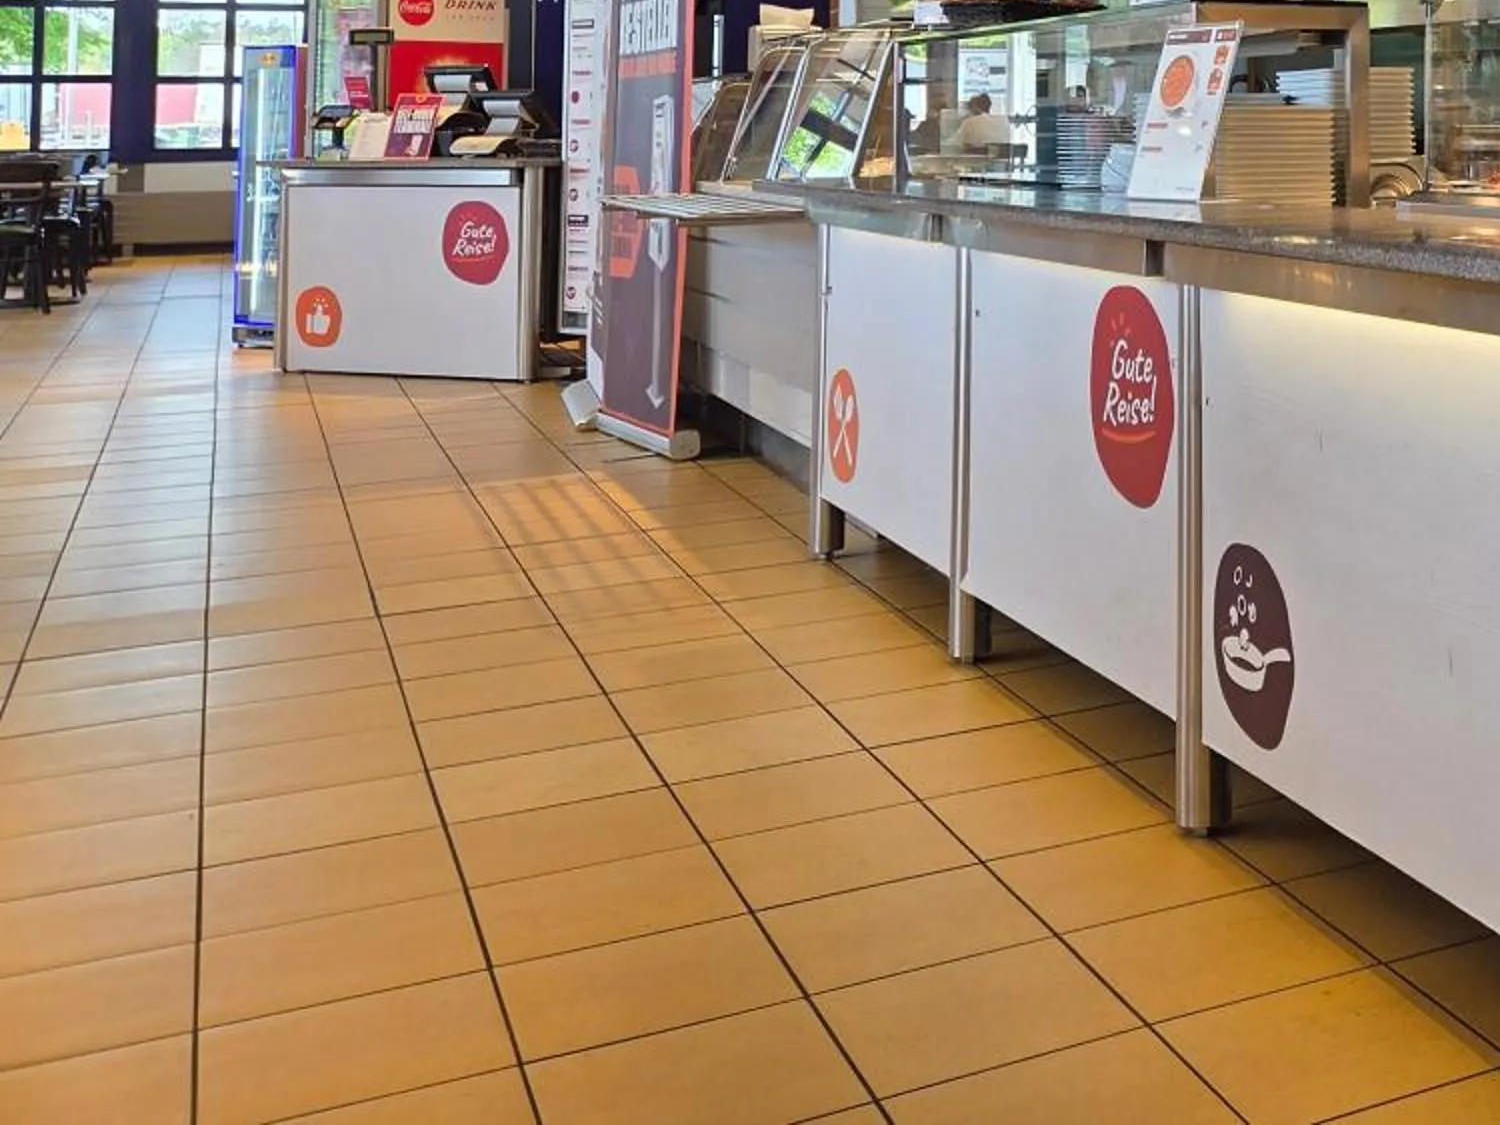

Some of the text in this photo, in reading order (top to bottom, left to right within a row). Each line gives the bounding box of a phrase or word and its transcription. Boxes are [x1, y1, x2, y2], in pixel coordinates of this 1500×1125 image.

[452, 233, 497, 257] Reise!
[461, 220, 494, 238] Gute
[1111, 338, 1154, 385] Gute
[1103, 375, 1158, 426] Reise!
